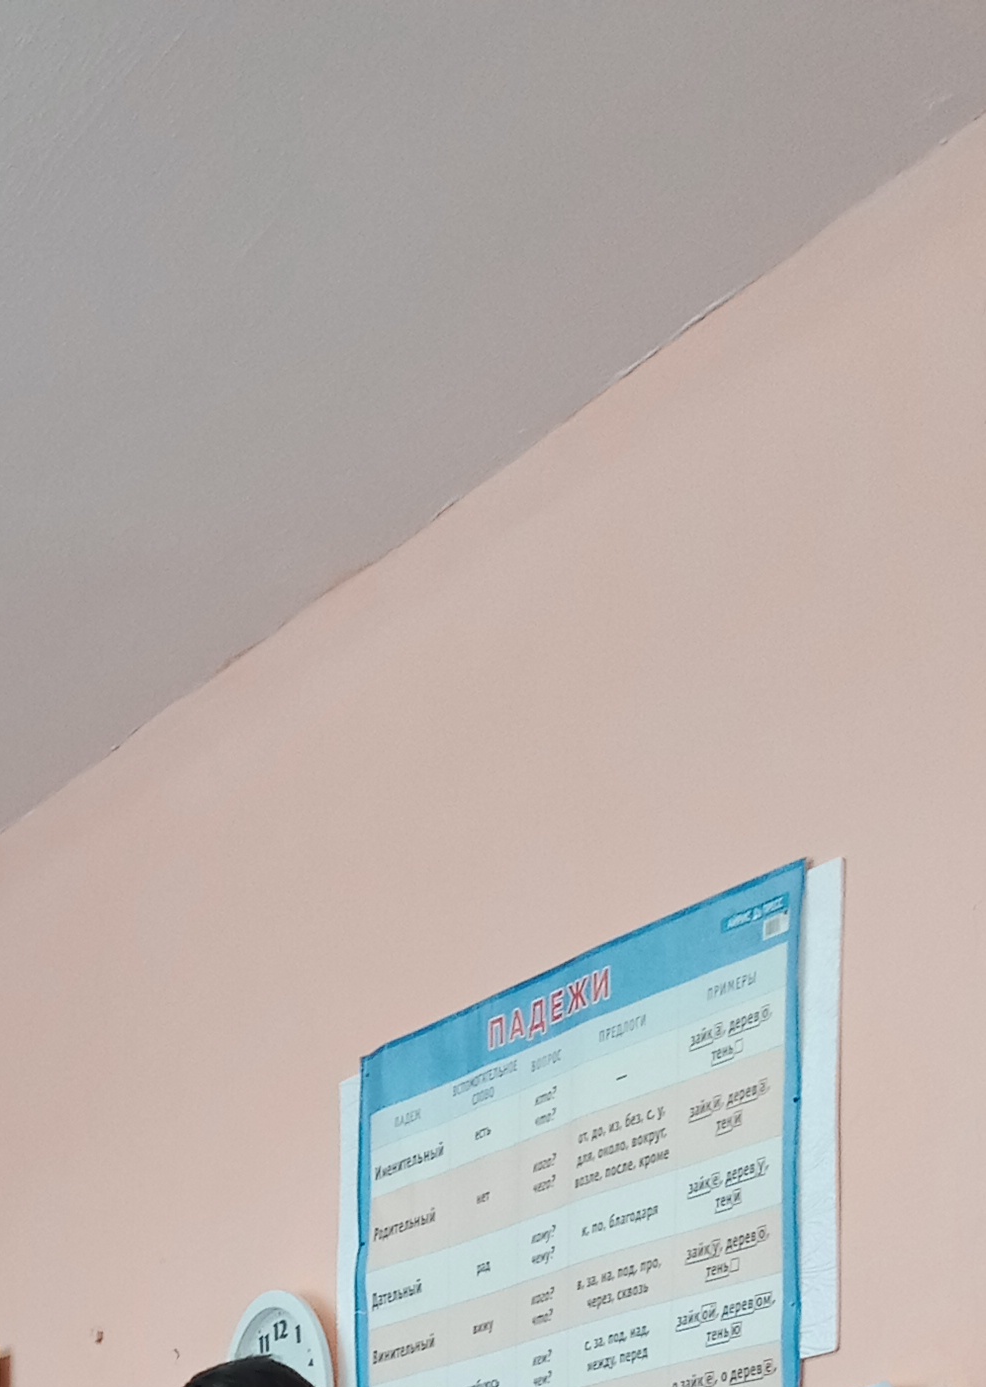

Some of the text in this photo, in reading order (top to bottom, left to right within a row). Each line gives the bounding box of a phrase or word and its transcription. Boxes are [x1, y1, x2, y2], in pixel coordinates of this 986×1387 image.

[707, 971, 757, 1001] ПРИМЕРЫ
[489, 966, 611, 1050] ПАДЕЖИ
[598, 1014, 647, 1043] ПРЕДЛОГИ
[375, 1141, 445, 1181] Именительный
[639, 1148, 670, 1170] кроме
[374, 1207, 436, 1242] Родительный
[609, 1203, 659, 1229] благодаря
[371, 1279, 422, 1311] Дательный
[258, 1333, 270, 1354] 11
[273, 1319, 288, 1341] 12
[295, 1324, 301, 1343] 1
[372, 1333, 435, 1365] Винительный
[619, 1346, 648, 1364] перед
